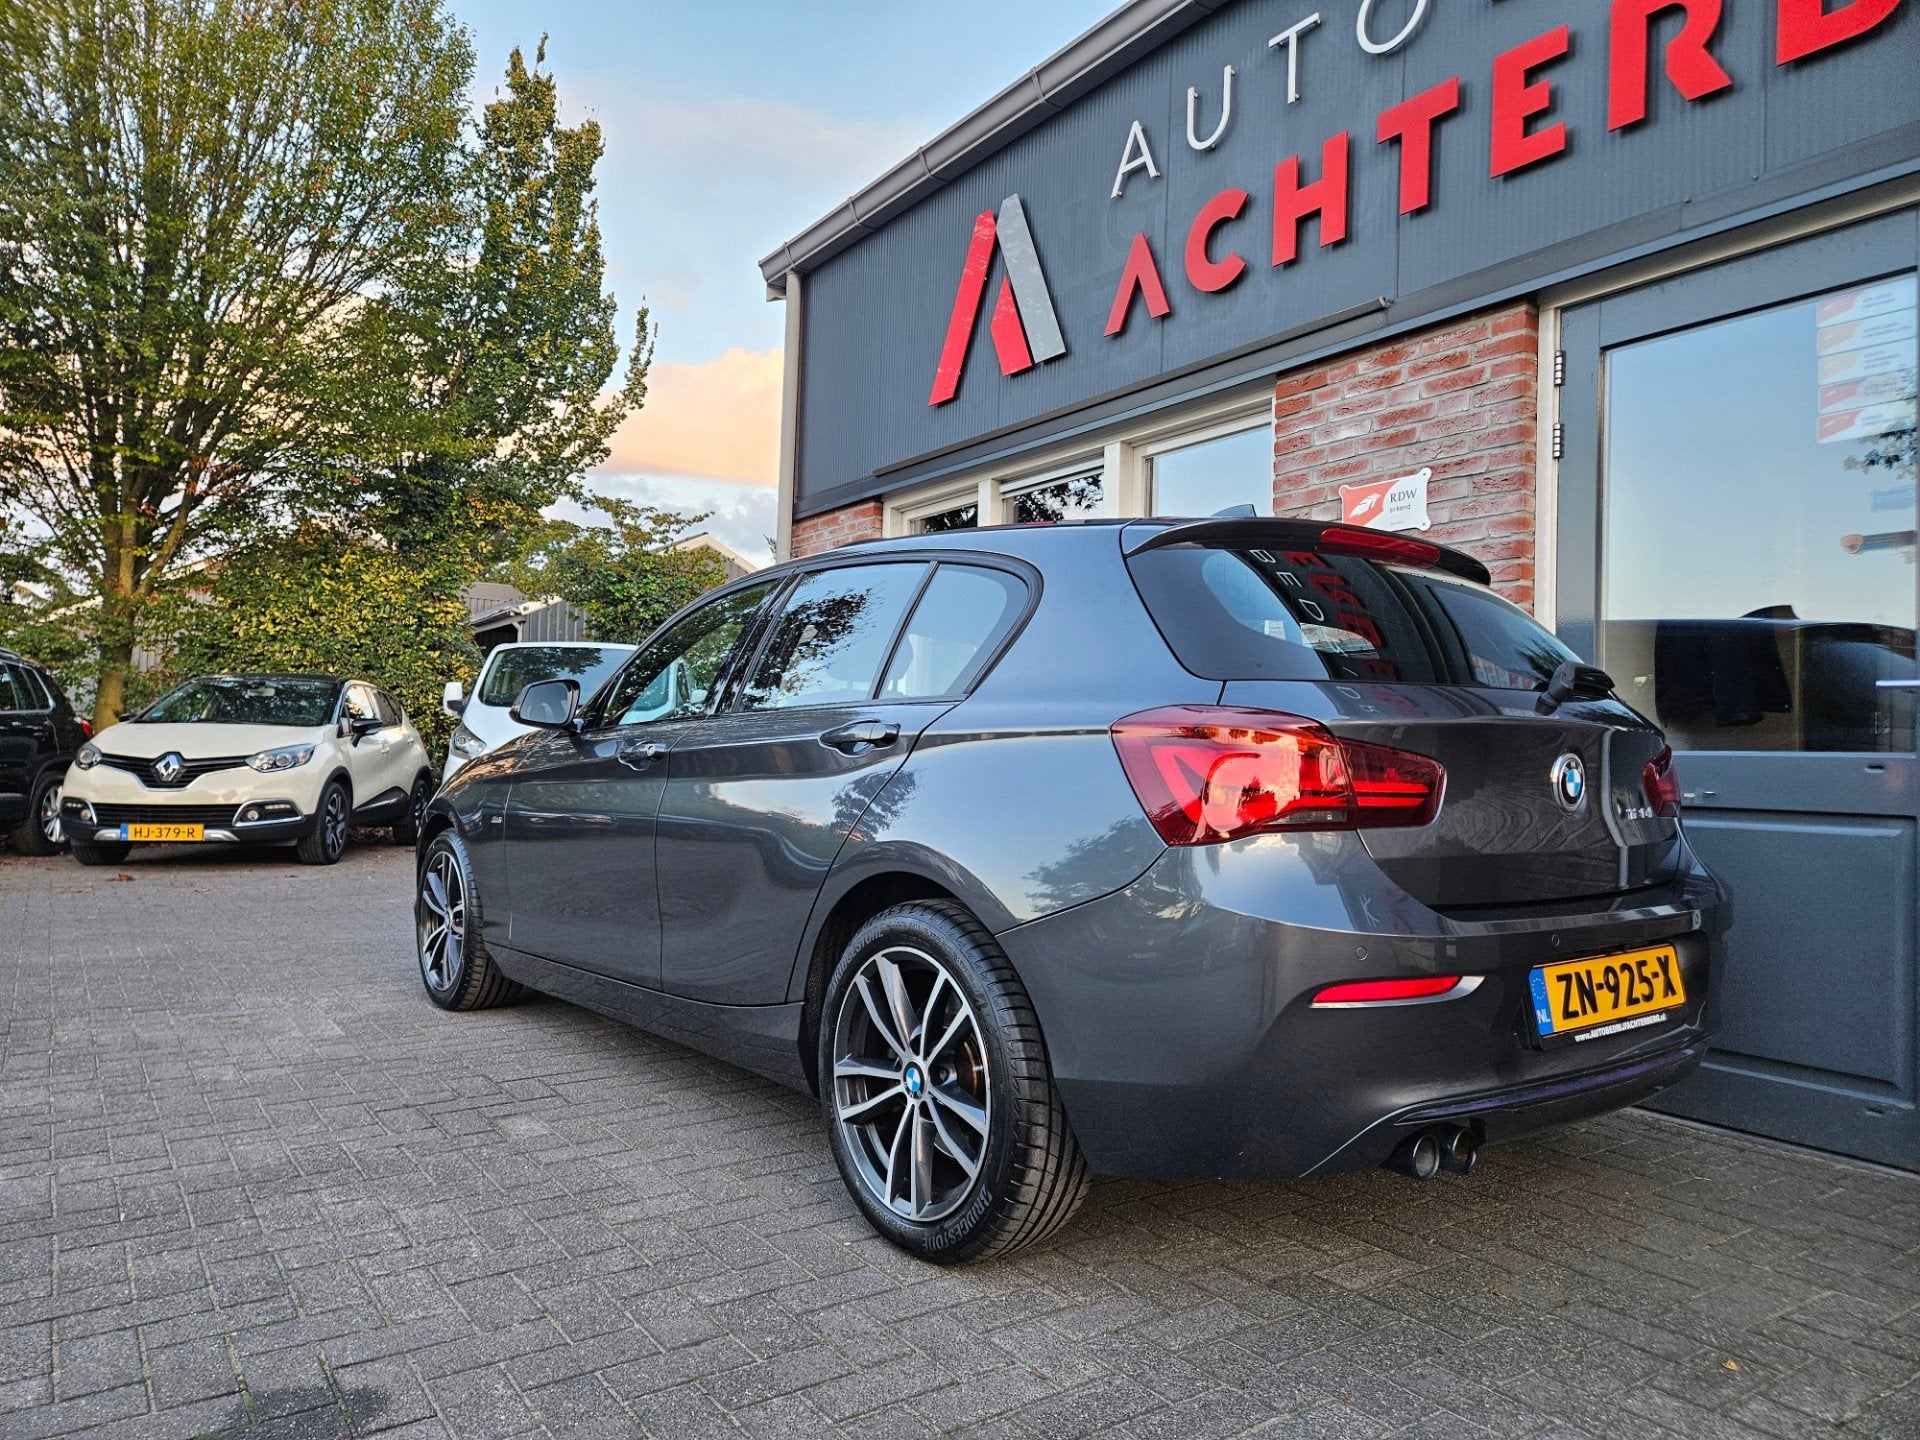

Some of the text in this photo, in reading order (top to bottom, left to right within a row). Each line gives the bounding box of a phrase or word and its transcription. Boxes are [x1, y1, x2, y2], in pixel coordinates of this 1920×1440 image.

[1110, 0, 1426, 198] AUTO
[1390, 488, 1418, 503] RDW
[1389, 504, 1412, 514] erkend
[133, 826, 196, 839] HJ-379-R
[1555, 954, 1678, 1021] ZN-925-X
[1536, 1008, 1551, 1025] NL
[922, 1183, 994, 1253] BRIDGESTONE
